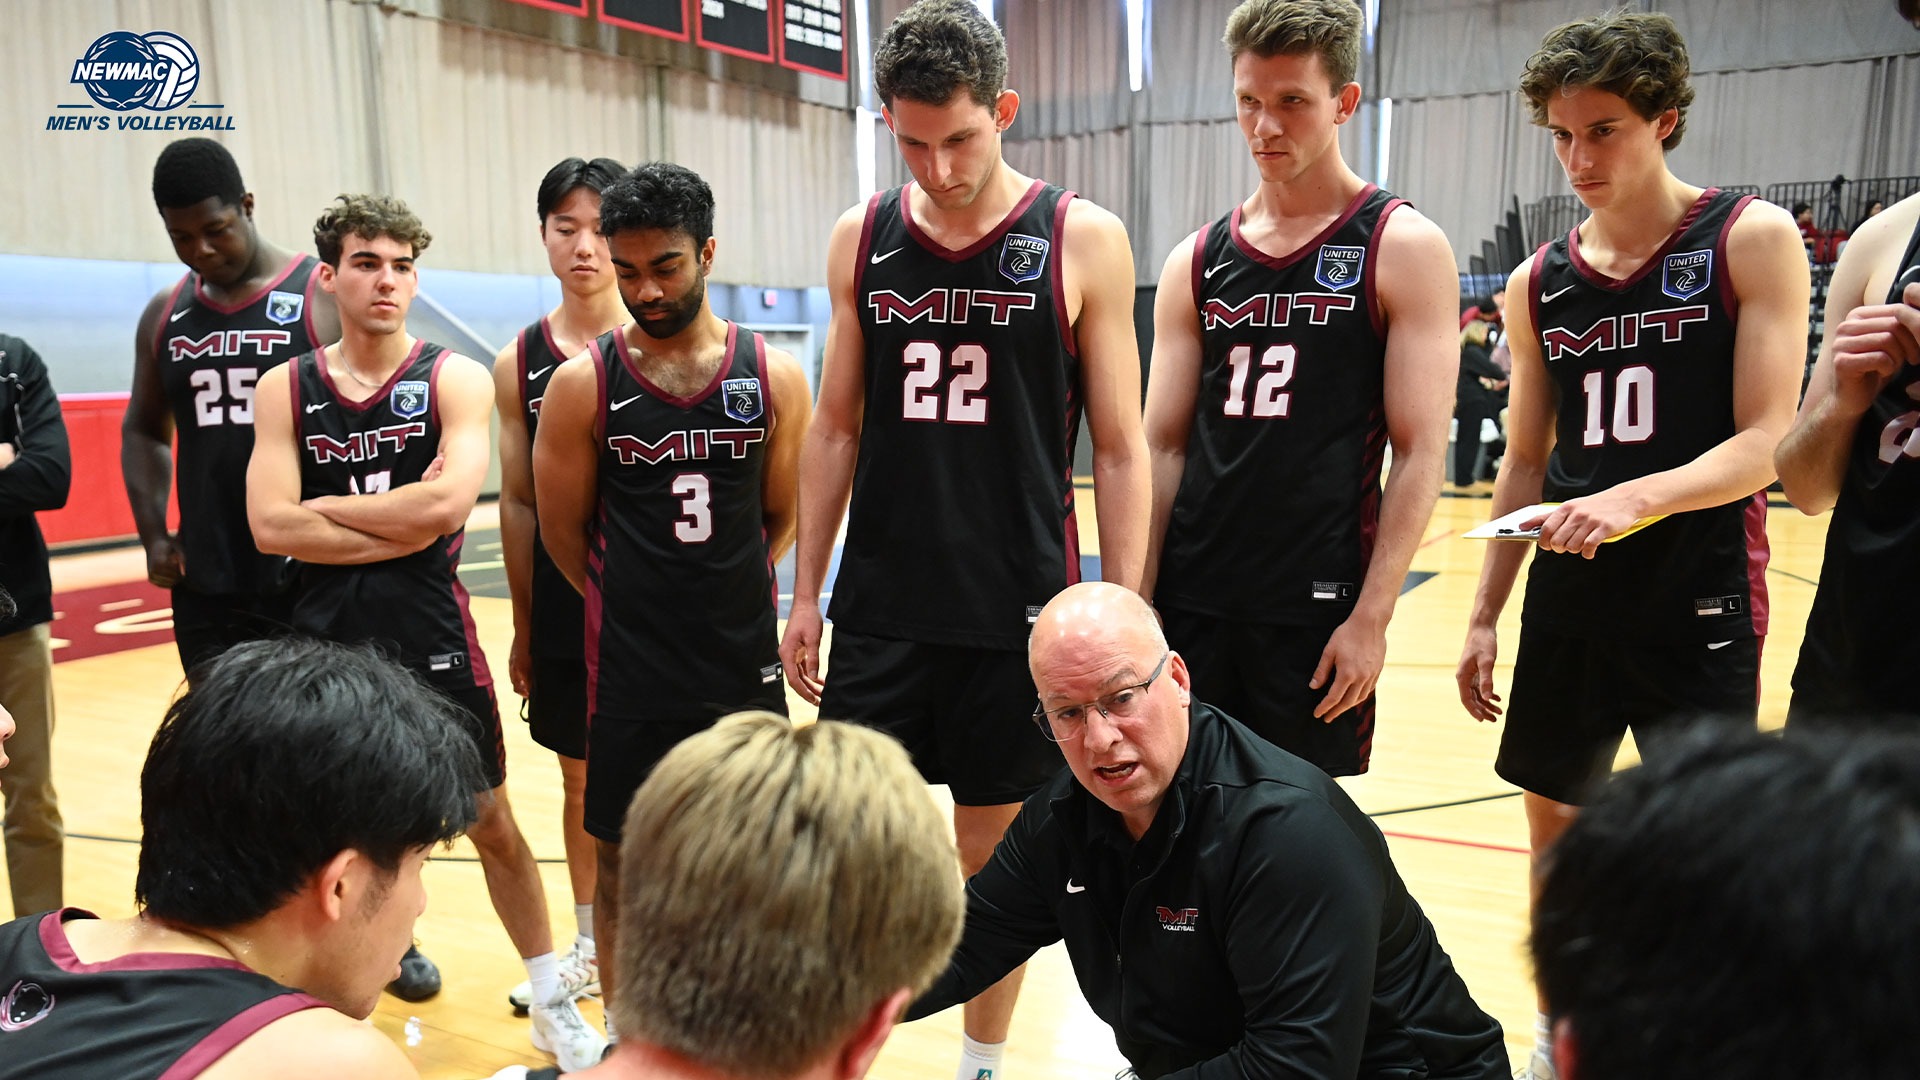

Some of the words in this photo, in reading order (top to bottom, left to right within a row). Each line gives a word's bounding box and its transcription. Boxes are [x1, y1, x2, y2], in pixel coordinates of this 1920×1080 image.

[1008, 238, 1044, 251] UNITED
[1323, 249, 1360, 259] UNITED
[1669, 254, 1707, 268] UNITED
[868, 288, 1036, 326] MIT
[1200, 292, 1356, 331] MIT
[168, 329, 291, 362] MIT
[1542, 304, 1709, 361] MIT
[190, 366, 258, 428] 25
[394, 385, 425, 393] UNITED
[726, 382, 757, 391] UNITED
[902, 341, 988, 424] 22
[1223, 342, 1298, 418] 12
[1582, 364, 1656, 448] 10
[305, 422, 426, 465] MIT
[607, 428, 765, 466] MIT
[671, 473, 713, 543] 3
[1729, 600, 1736, 610] L
[1155, 906, 1199, 925] MIT
